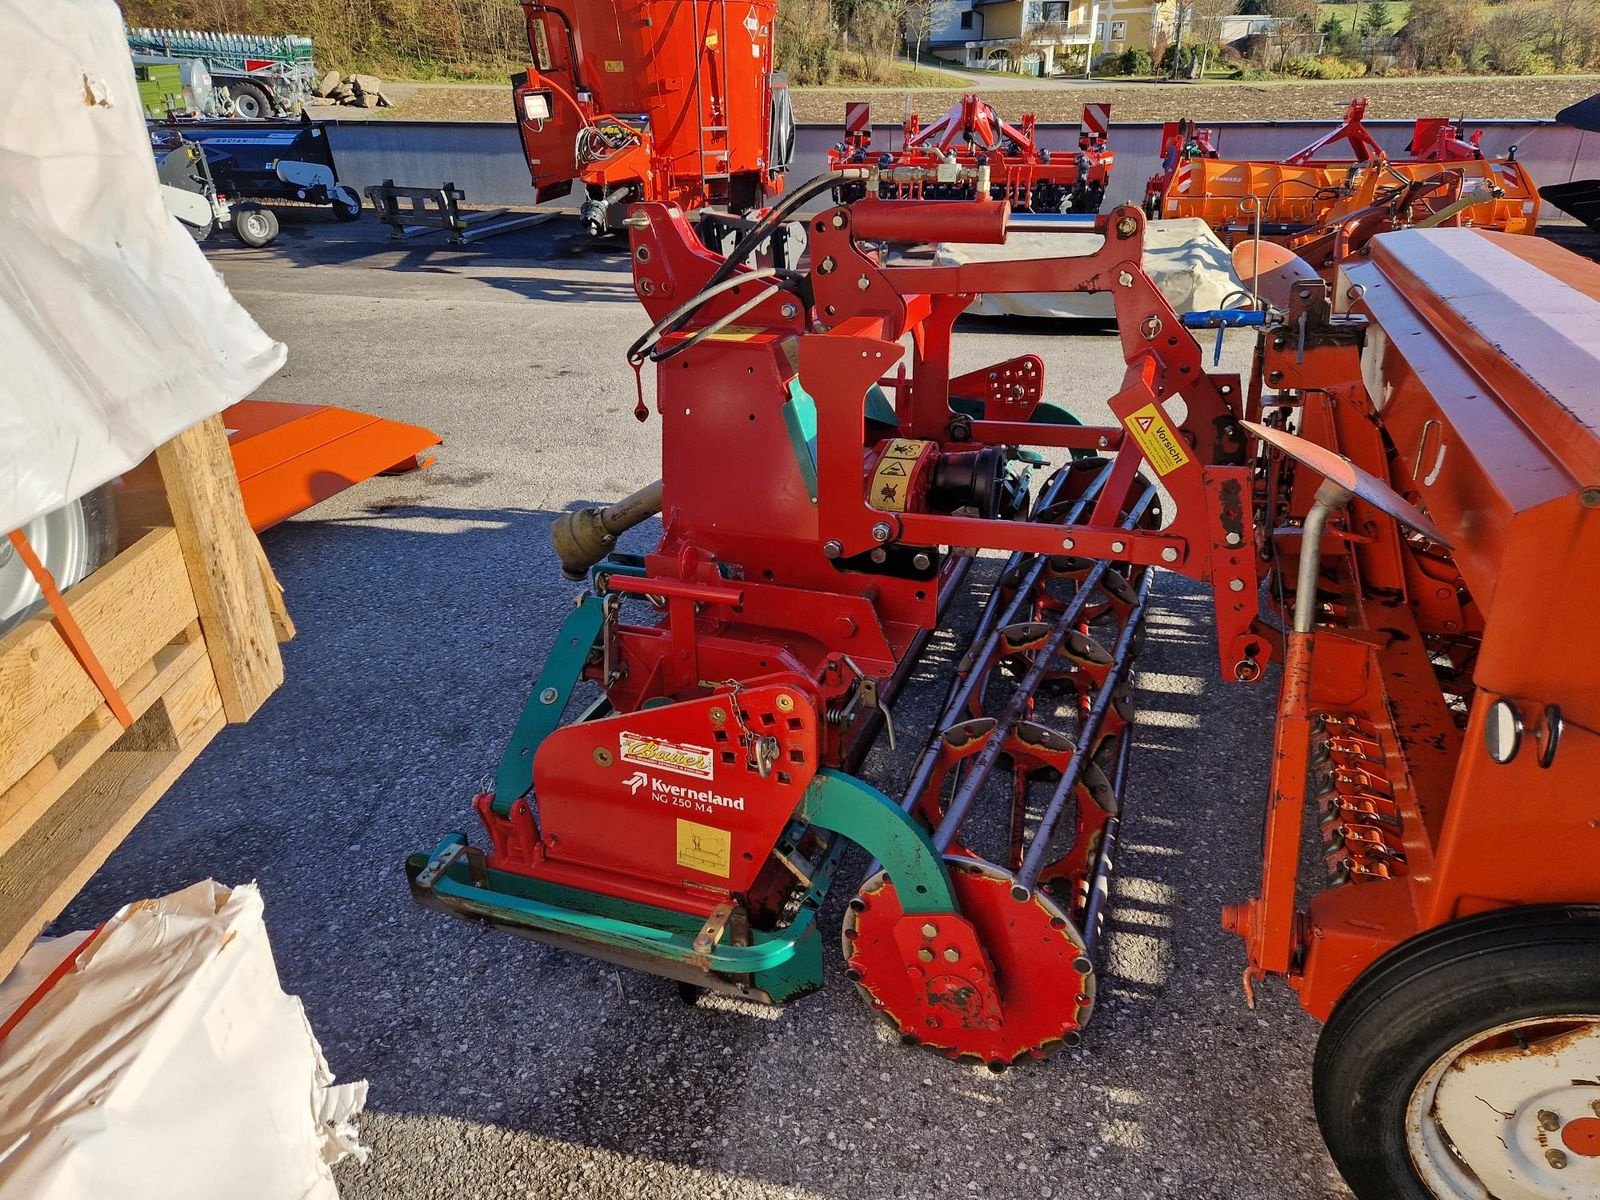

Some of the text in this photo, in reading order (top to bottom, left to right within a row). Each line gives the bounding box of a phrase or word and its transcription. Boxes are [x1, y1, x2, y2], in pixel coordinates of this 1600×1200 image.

[1156, 426, 1183, 464] Vorsicht
[628, 741, 708, 769] Bauer
[652, 778, 744, 810] Kverneland
[652, 792, 713, 814] NG 250 M4
